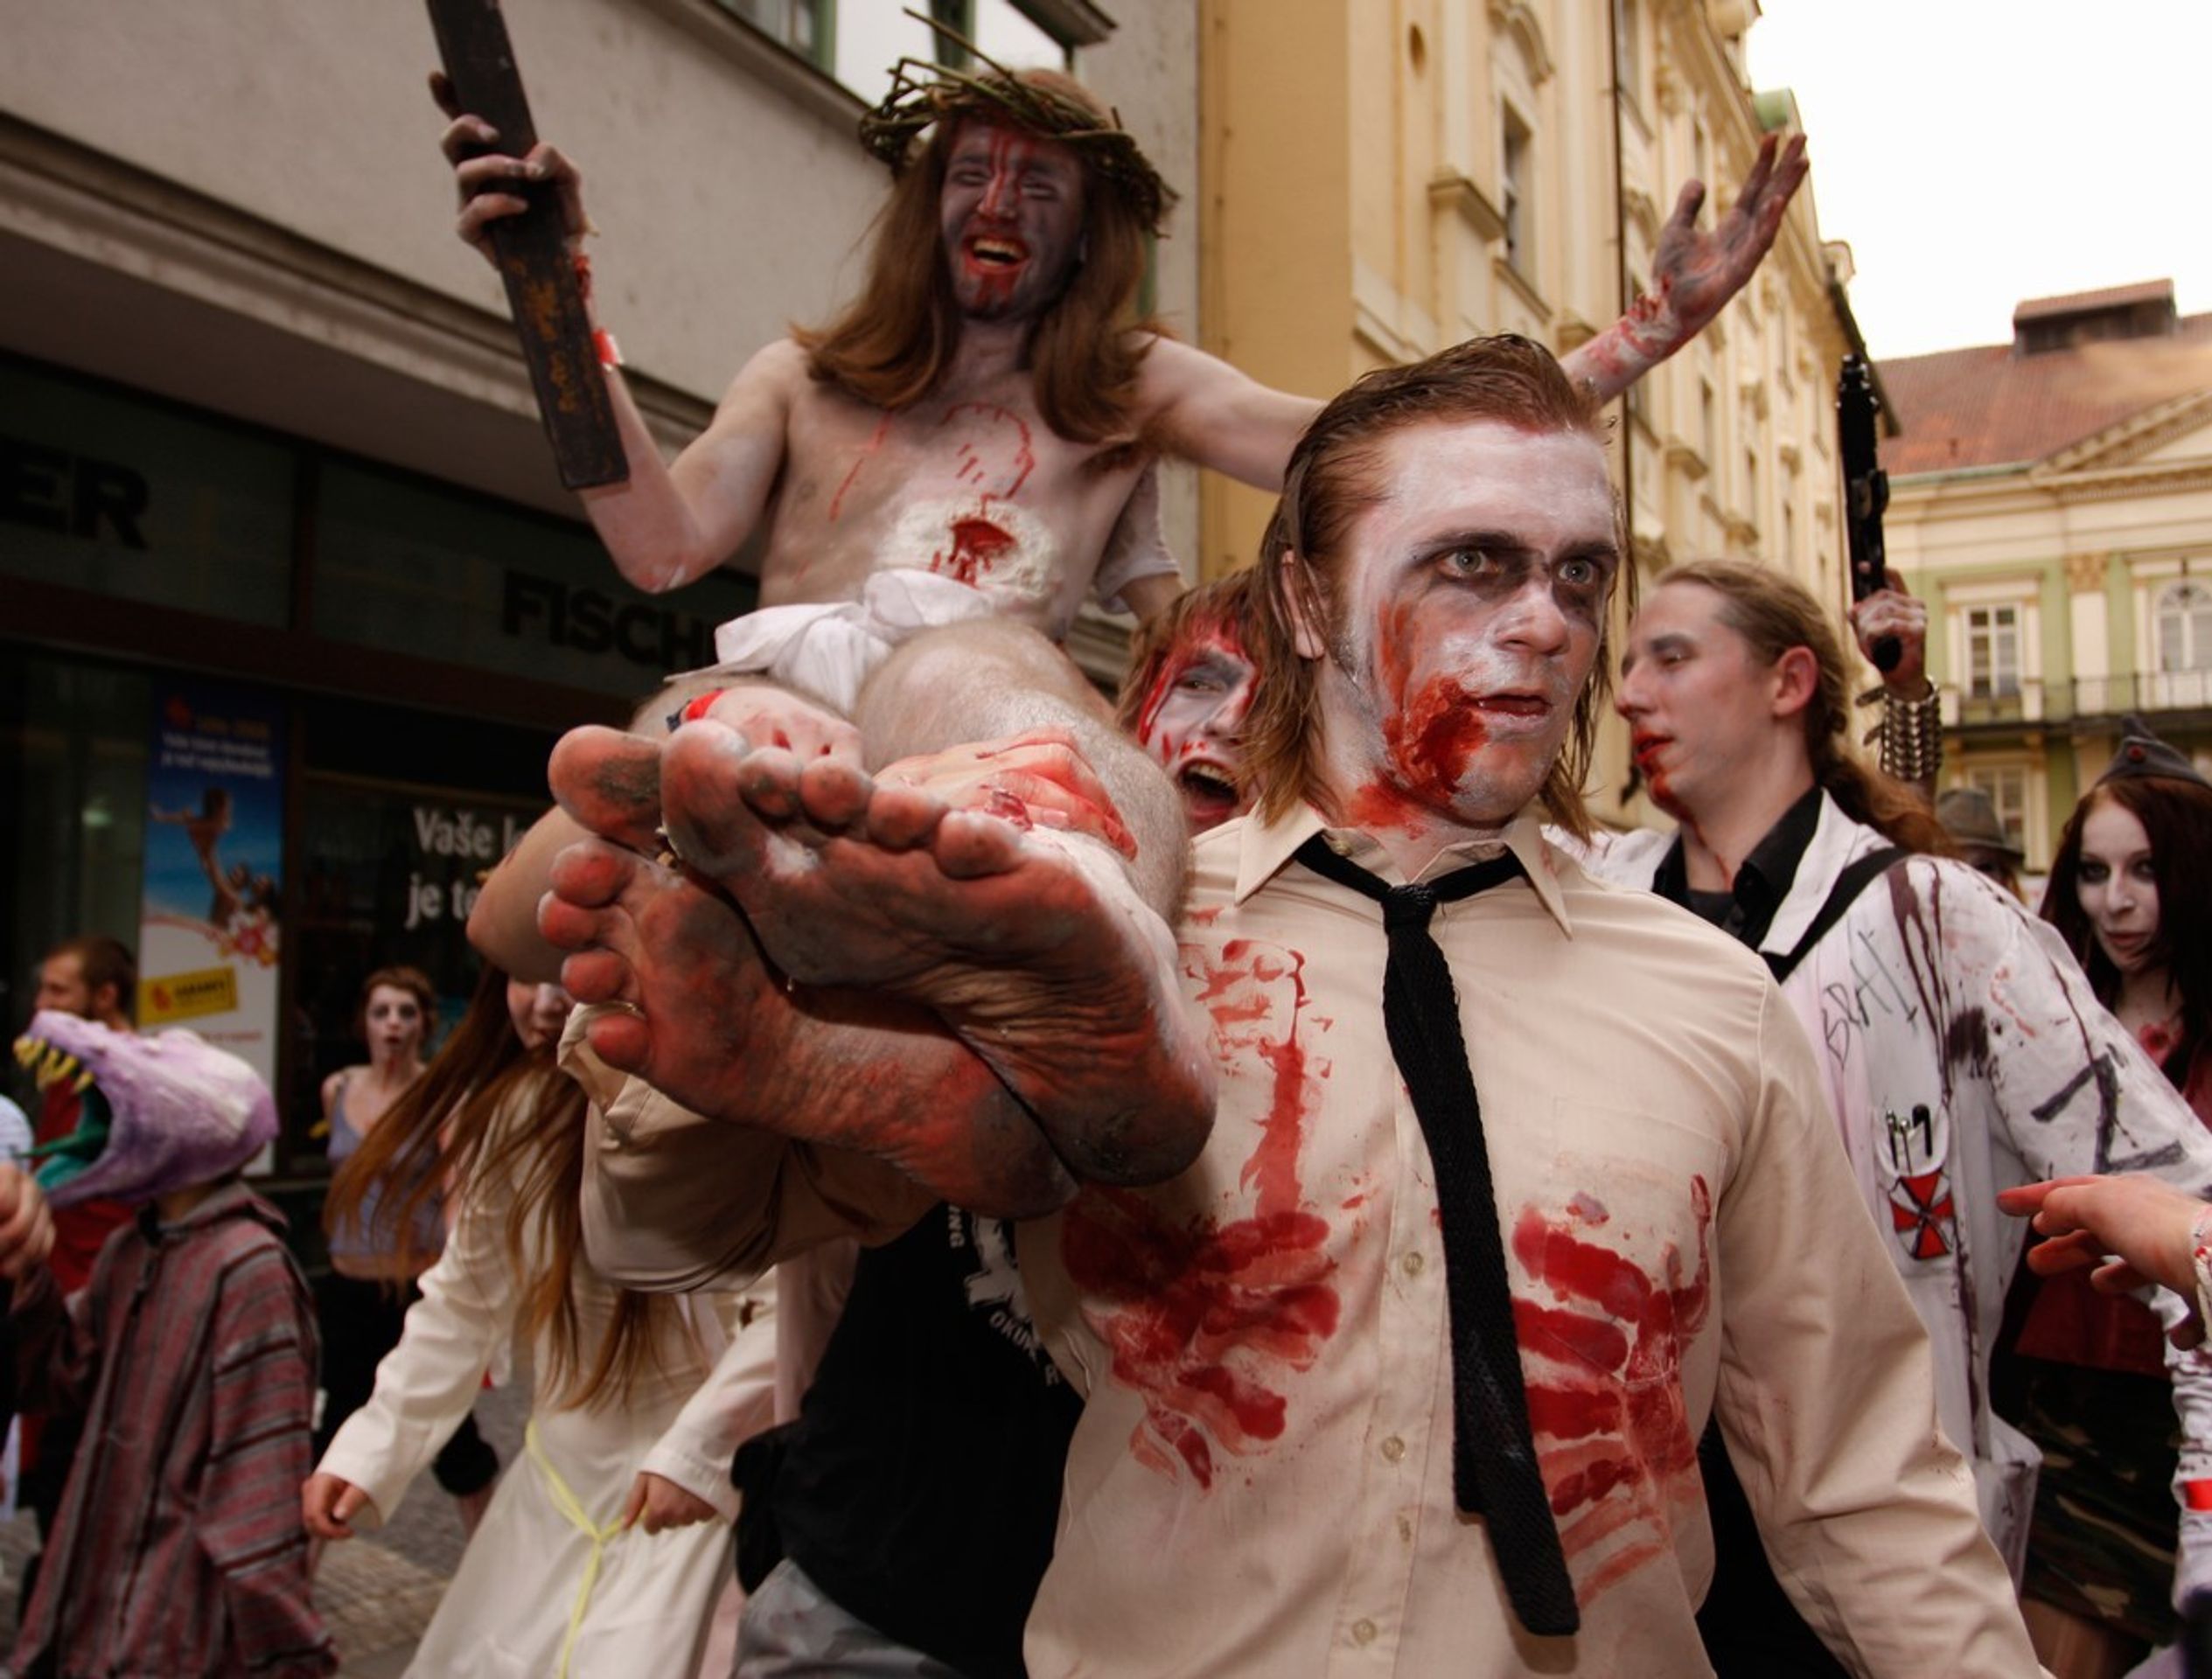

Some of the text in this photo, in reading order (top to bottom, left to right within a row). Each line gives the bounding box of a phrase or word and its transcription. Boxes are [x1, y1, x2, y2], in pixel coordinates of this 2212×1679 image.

[504, 569, 714, 654] FISCH
[412, 805, 494, 860] Vaše
[403, 871, 443, 931] je
